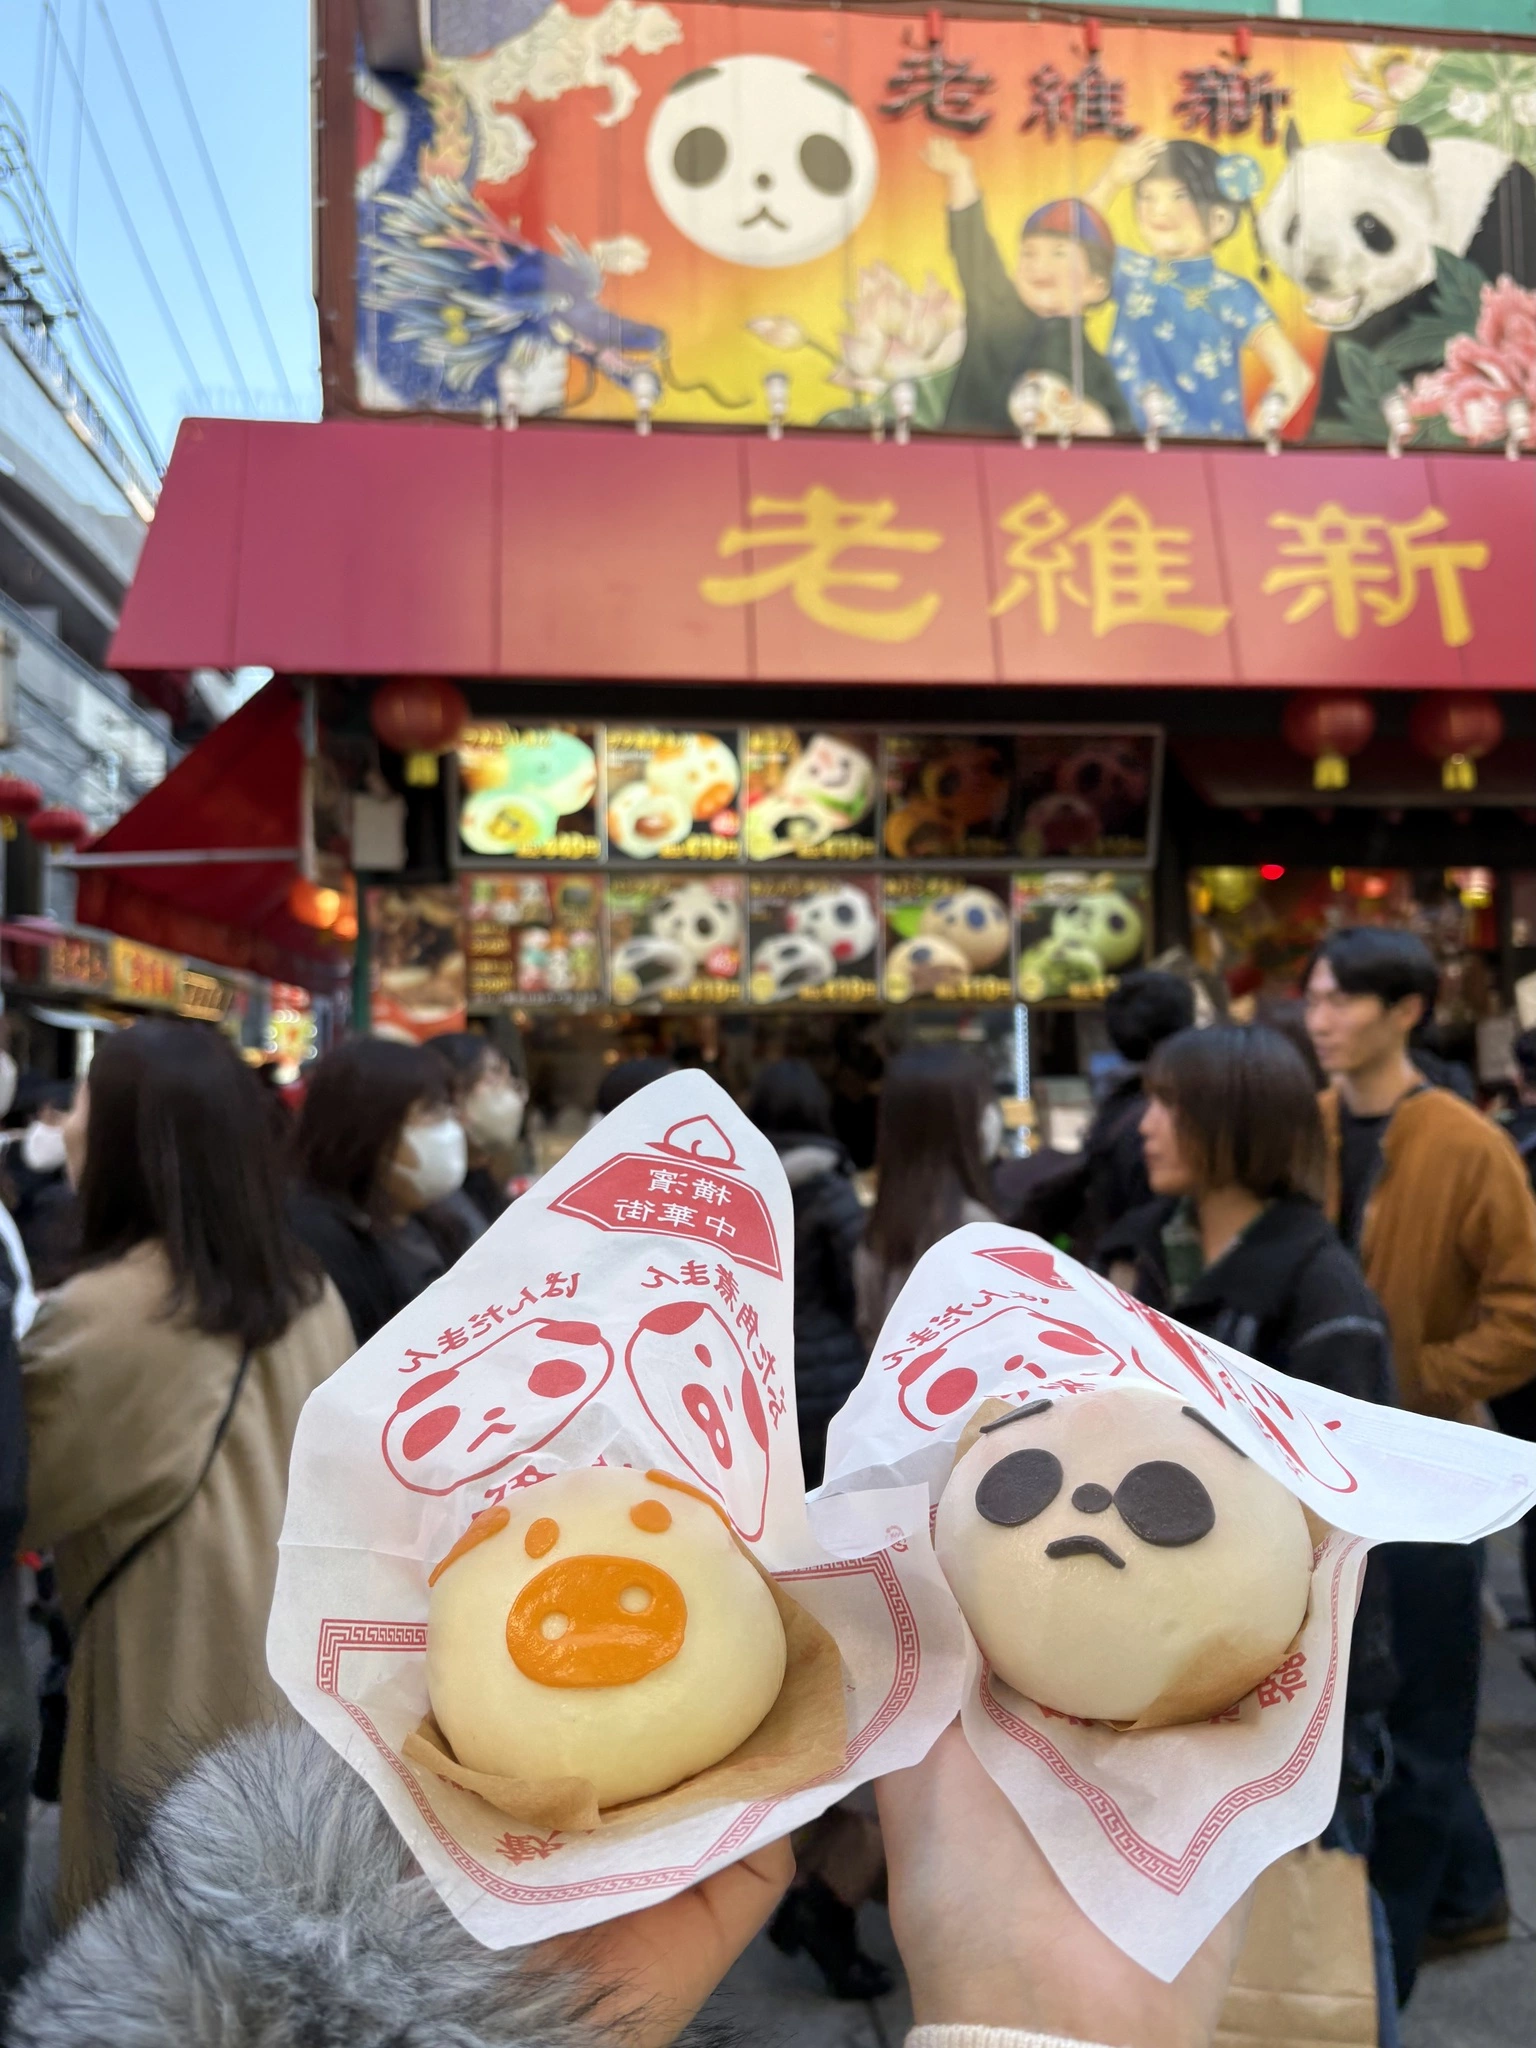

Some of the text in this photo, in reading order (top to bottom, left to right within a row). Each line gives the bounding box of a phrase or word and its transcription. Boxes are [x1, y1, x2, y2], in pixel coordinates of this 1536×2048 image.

[878, 44, 1292, 145] 老維新
[699, 484, 1490, 648] 老維新
